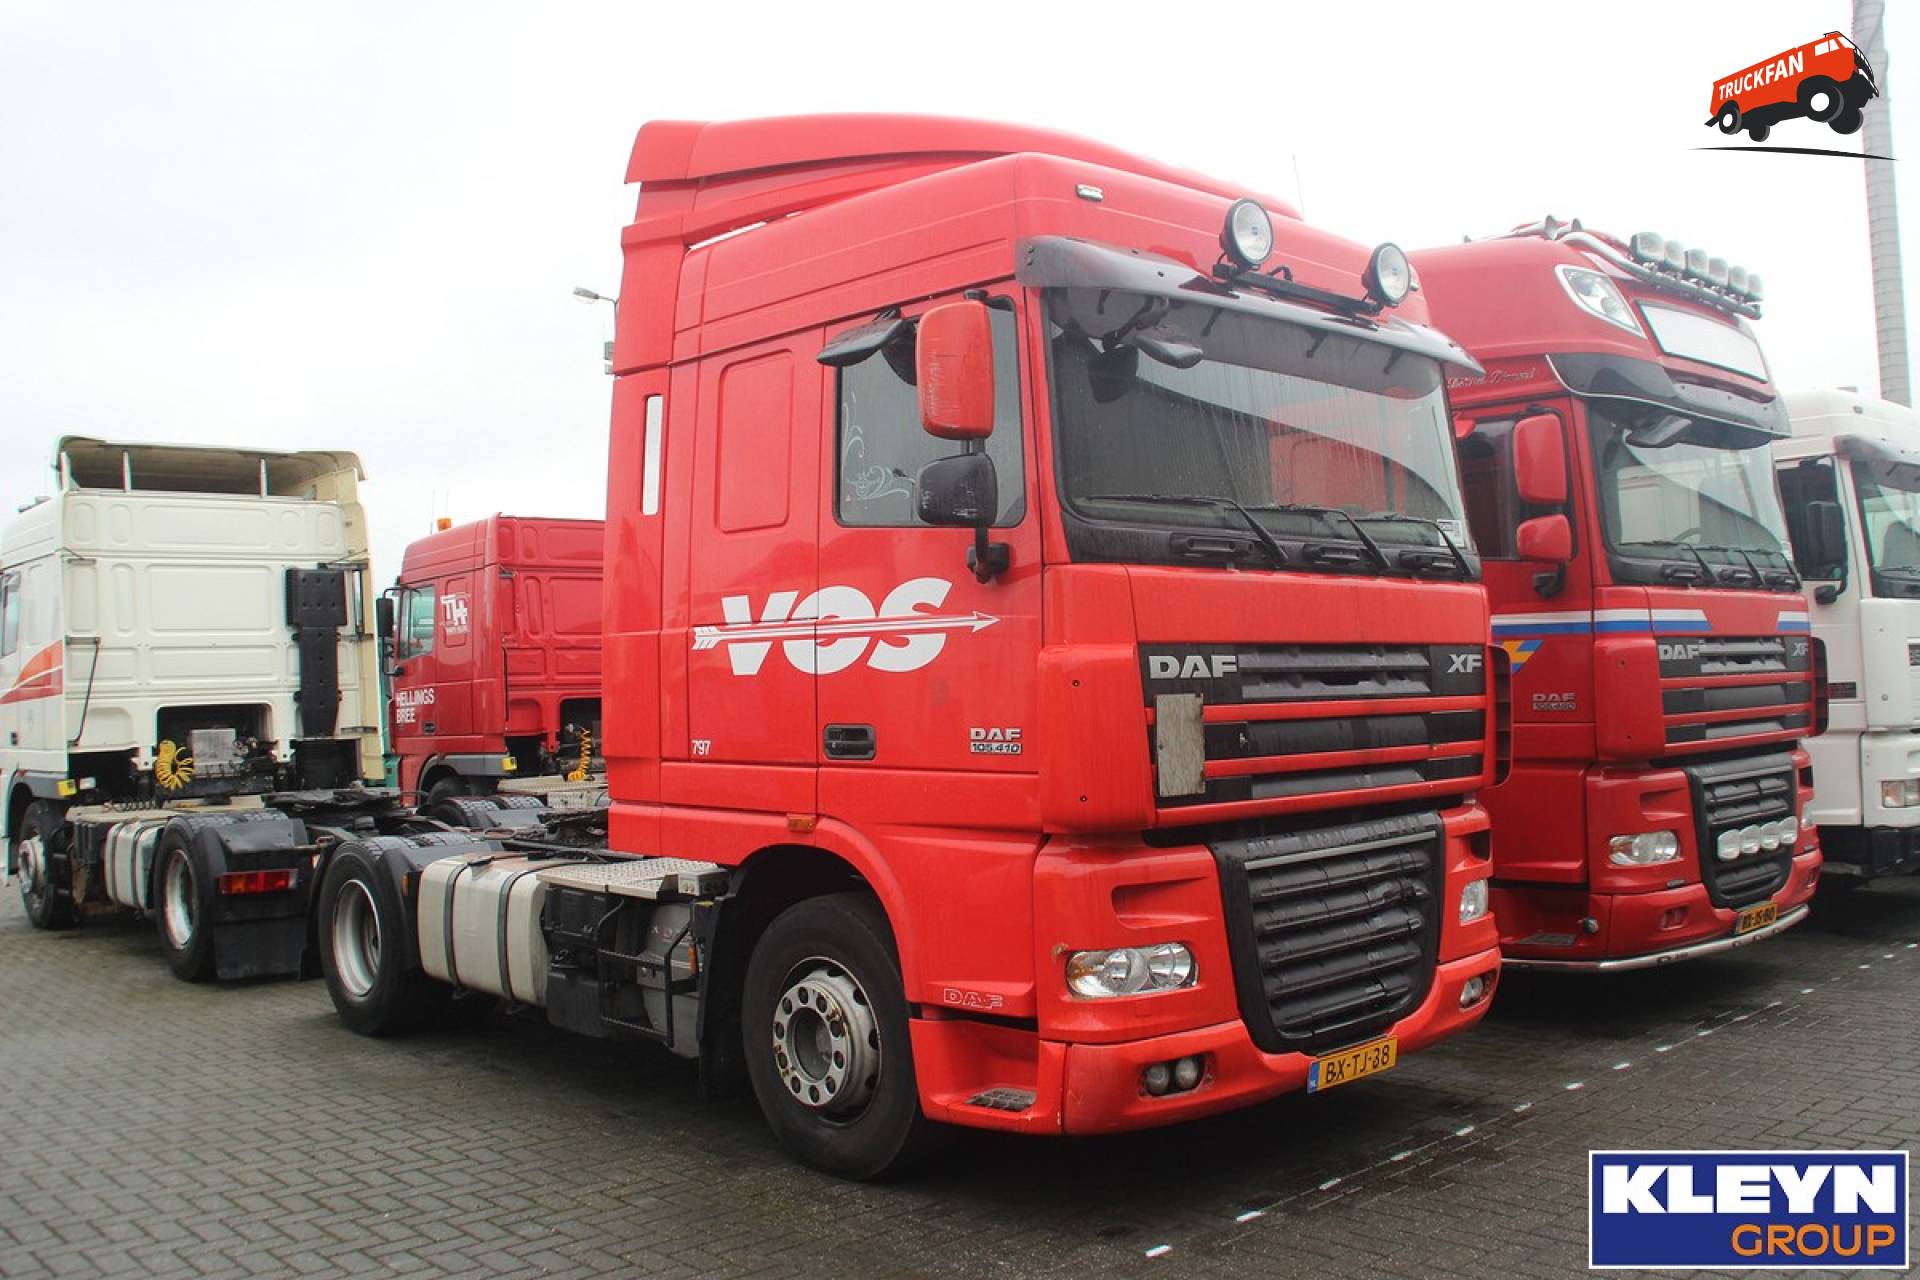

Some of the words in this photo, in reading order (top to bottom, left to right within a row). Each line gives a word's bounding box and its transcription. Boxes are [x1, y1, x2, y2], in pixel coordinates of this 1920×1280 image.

[721, 577, 953, 675] VOS
[1658, 644, 1699, 660] DAF
[1792, 641, 1808, 657] XF
[1149, 655, 1238, 679] DAF
[1447, 653, 1483, 674] XF
[396, 688, 435, 706] HELLINGS
[1533, 692, 1576, 702] DAF
[396, 708, 417, 724] BREE
[970, 727, 1021, 741] DAF
[692, 740, 711, 756] 797
[971, 742, 1021, 753] 105.410
[943, 988, 1004, 1010] DAF
[1326, 1044, 1390, 1083] BX-TJ-38
